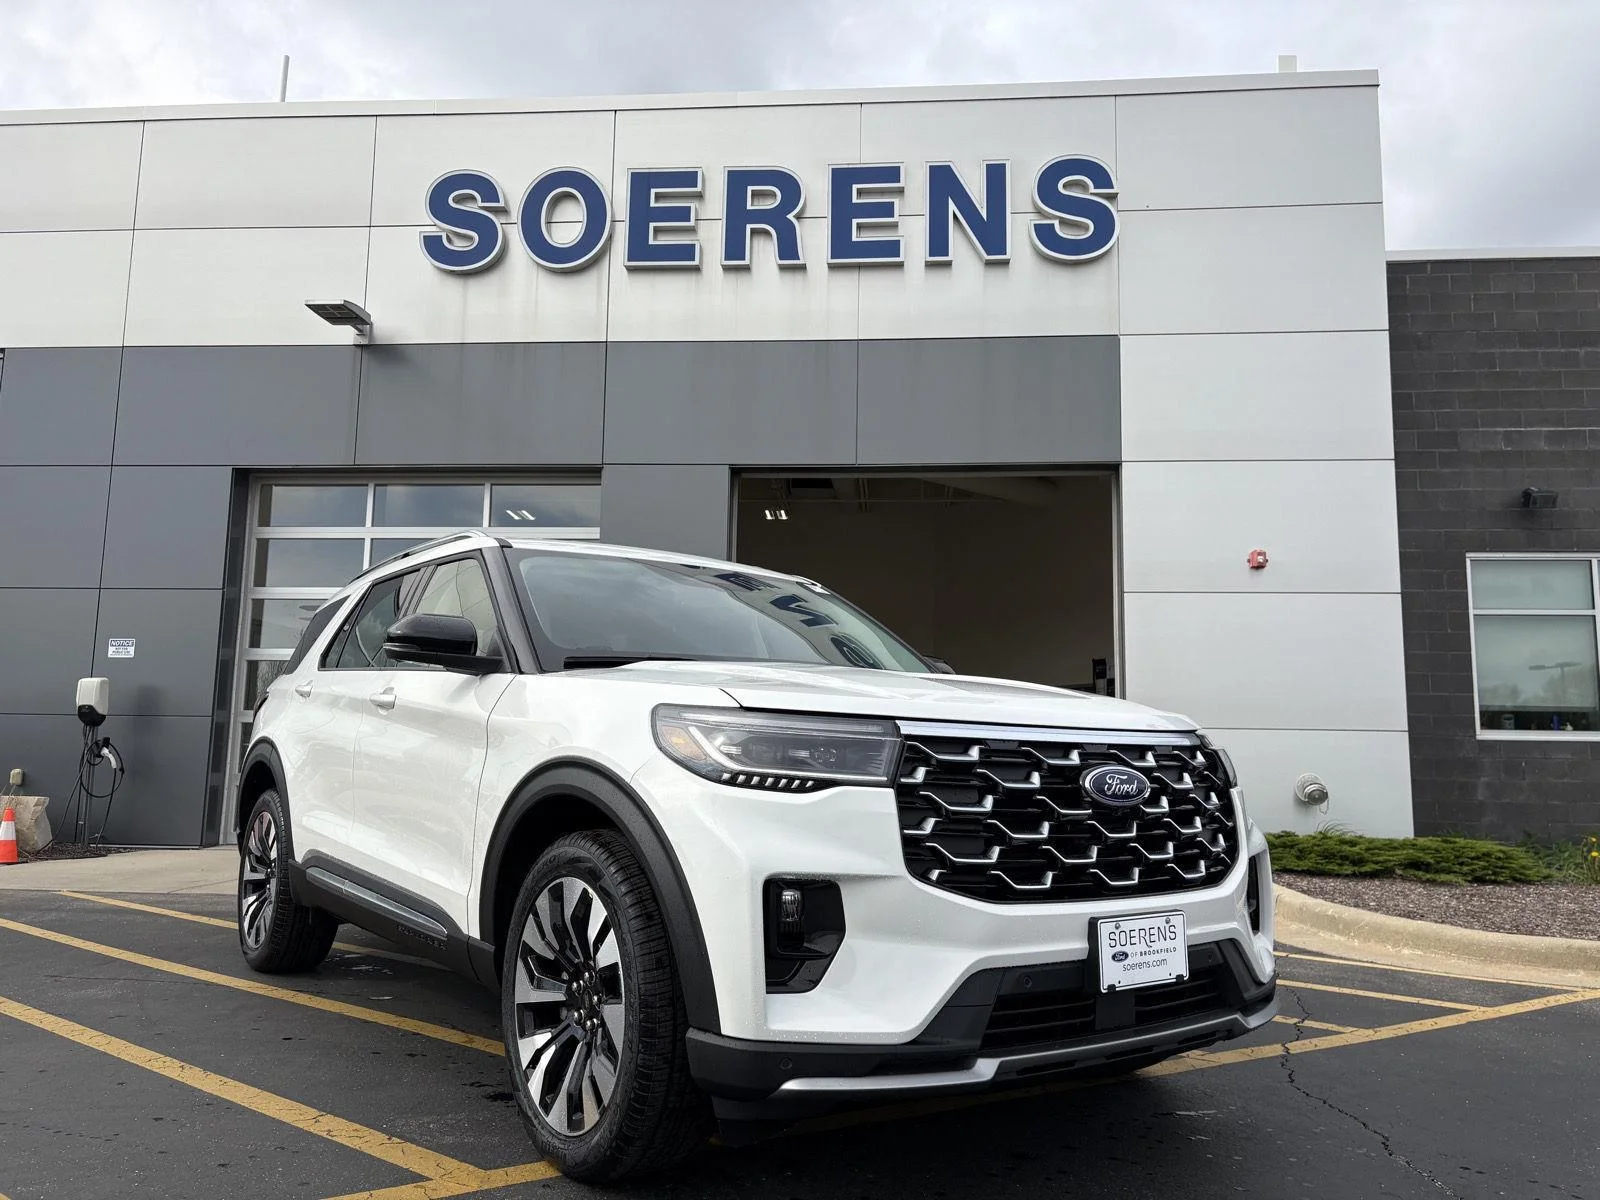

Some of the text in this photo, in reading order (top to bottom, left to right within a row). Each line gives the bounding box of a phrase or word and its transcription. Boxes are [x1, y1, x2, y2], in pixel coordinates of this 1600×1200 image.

[419, 155, 1119, 274] SOERENS
[1104, 773, 1139, 796] Ford
[1108, 924, 1177, 948] SOERENS
[1140, 947, 1177, 957] BROOKFIELD
[1122, 958, 1168, 972] soerens.com
